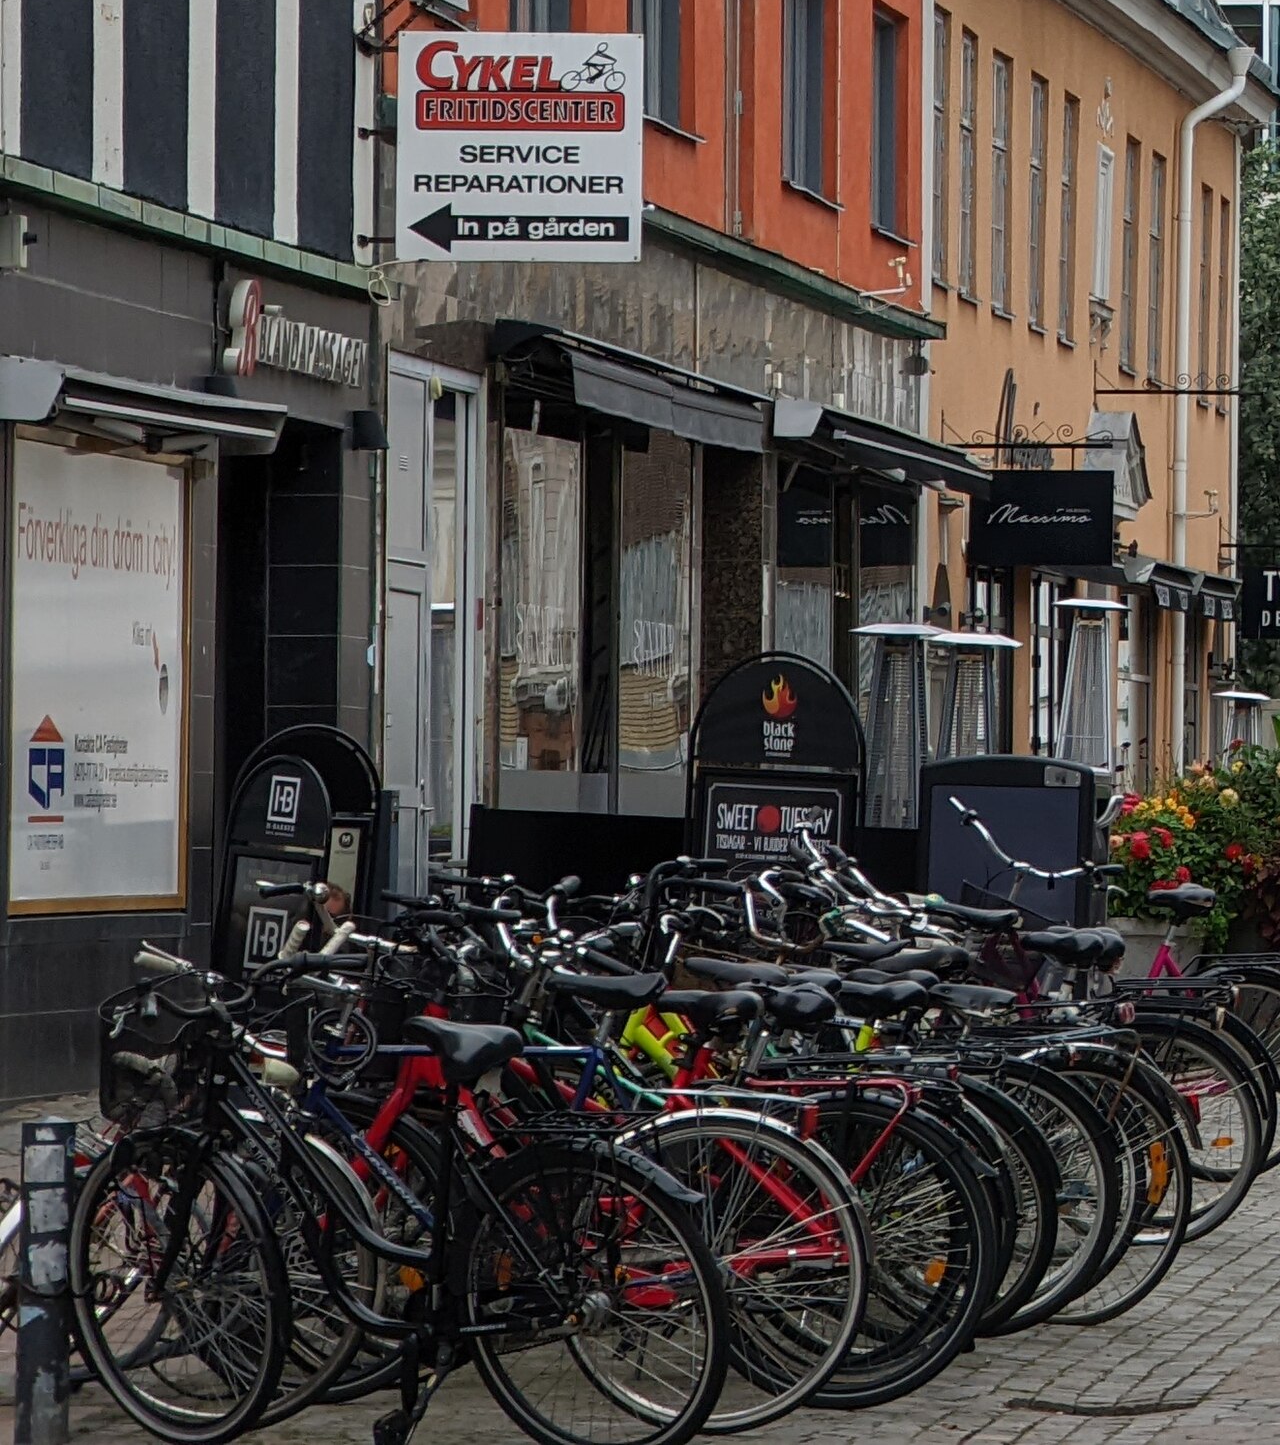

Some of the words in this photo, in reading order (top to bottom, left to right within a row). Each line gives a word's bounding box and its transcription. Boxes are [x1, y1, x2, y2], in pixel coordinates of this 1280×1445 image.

[416, 40, 562, 92] CYKEL
[423, 98, 617, 124] FRITIDSCENTER
[459, 145, 580, 164] SERVICE
[413, 174, 624, 194] REPARATIONER
[457, 217, 479, 236] In
[487, 216, 519, 240] på
[528, 216, 615, 241] gården
[986, 503, 1092, 524] Massimo
[17, 502, 87, 580] Förverkliga
[91, 512, 109, 569] din
[113, 518, 143, 572] dröm
[153, 524, 176, 590] city!
[763, 721, 795, 737] black
[764, 735, 794, 751] stone
[717, 802, 758, 831] SWEET
[780, 806, 833, 835] TUESAY
